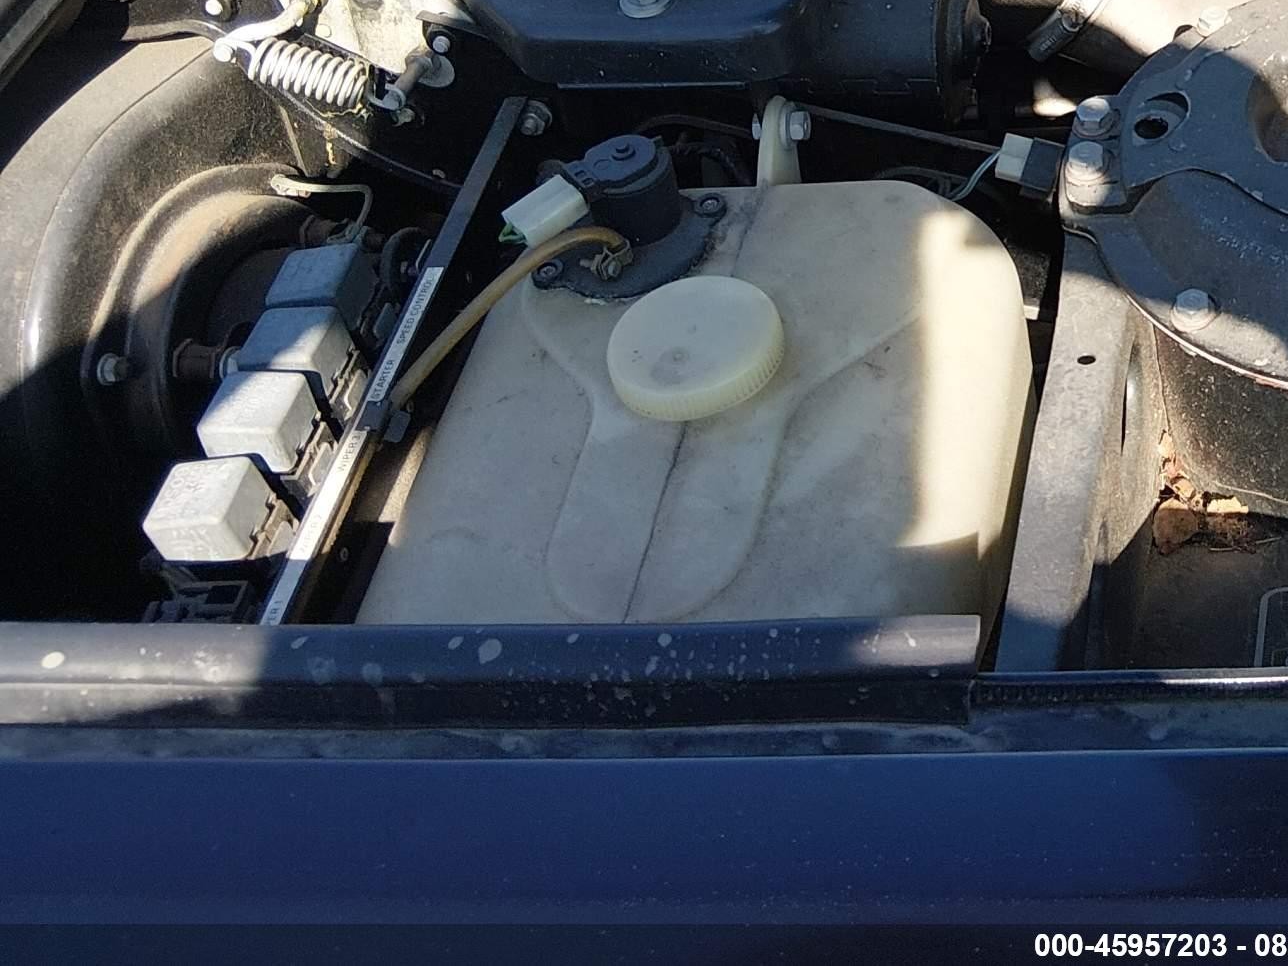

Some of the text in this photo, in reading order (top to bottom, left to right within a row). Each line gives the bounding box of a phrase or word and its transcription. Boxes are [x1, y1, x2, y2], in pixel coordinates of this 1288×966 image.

[396, 316, 415, 344] SPEED
[370, 359, 395, 400] STARTER
[338, 441, 358, 472] WIPER
